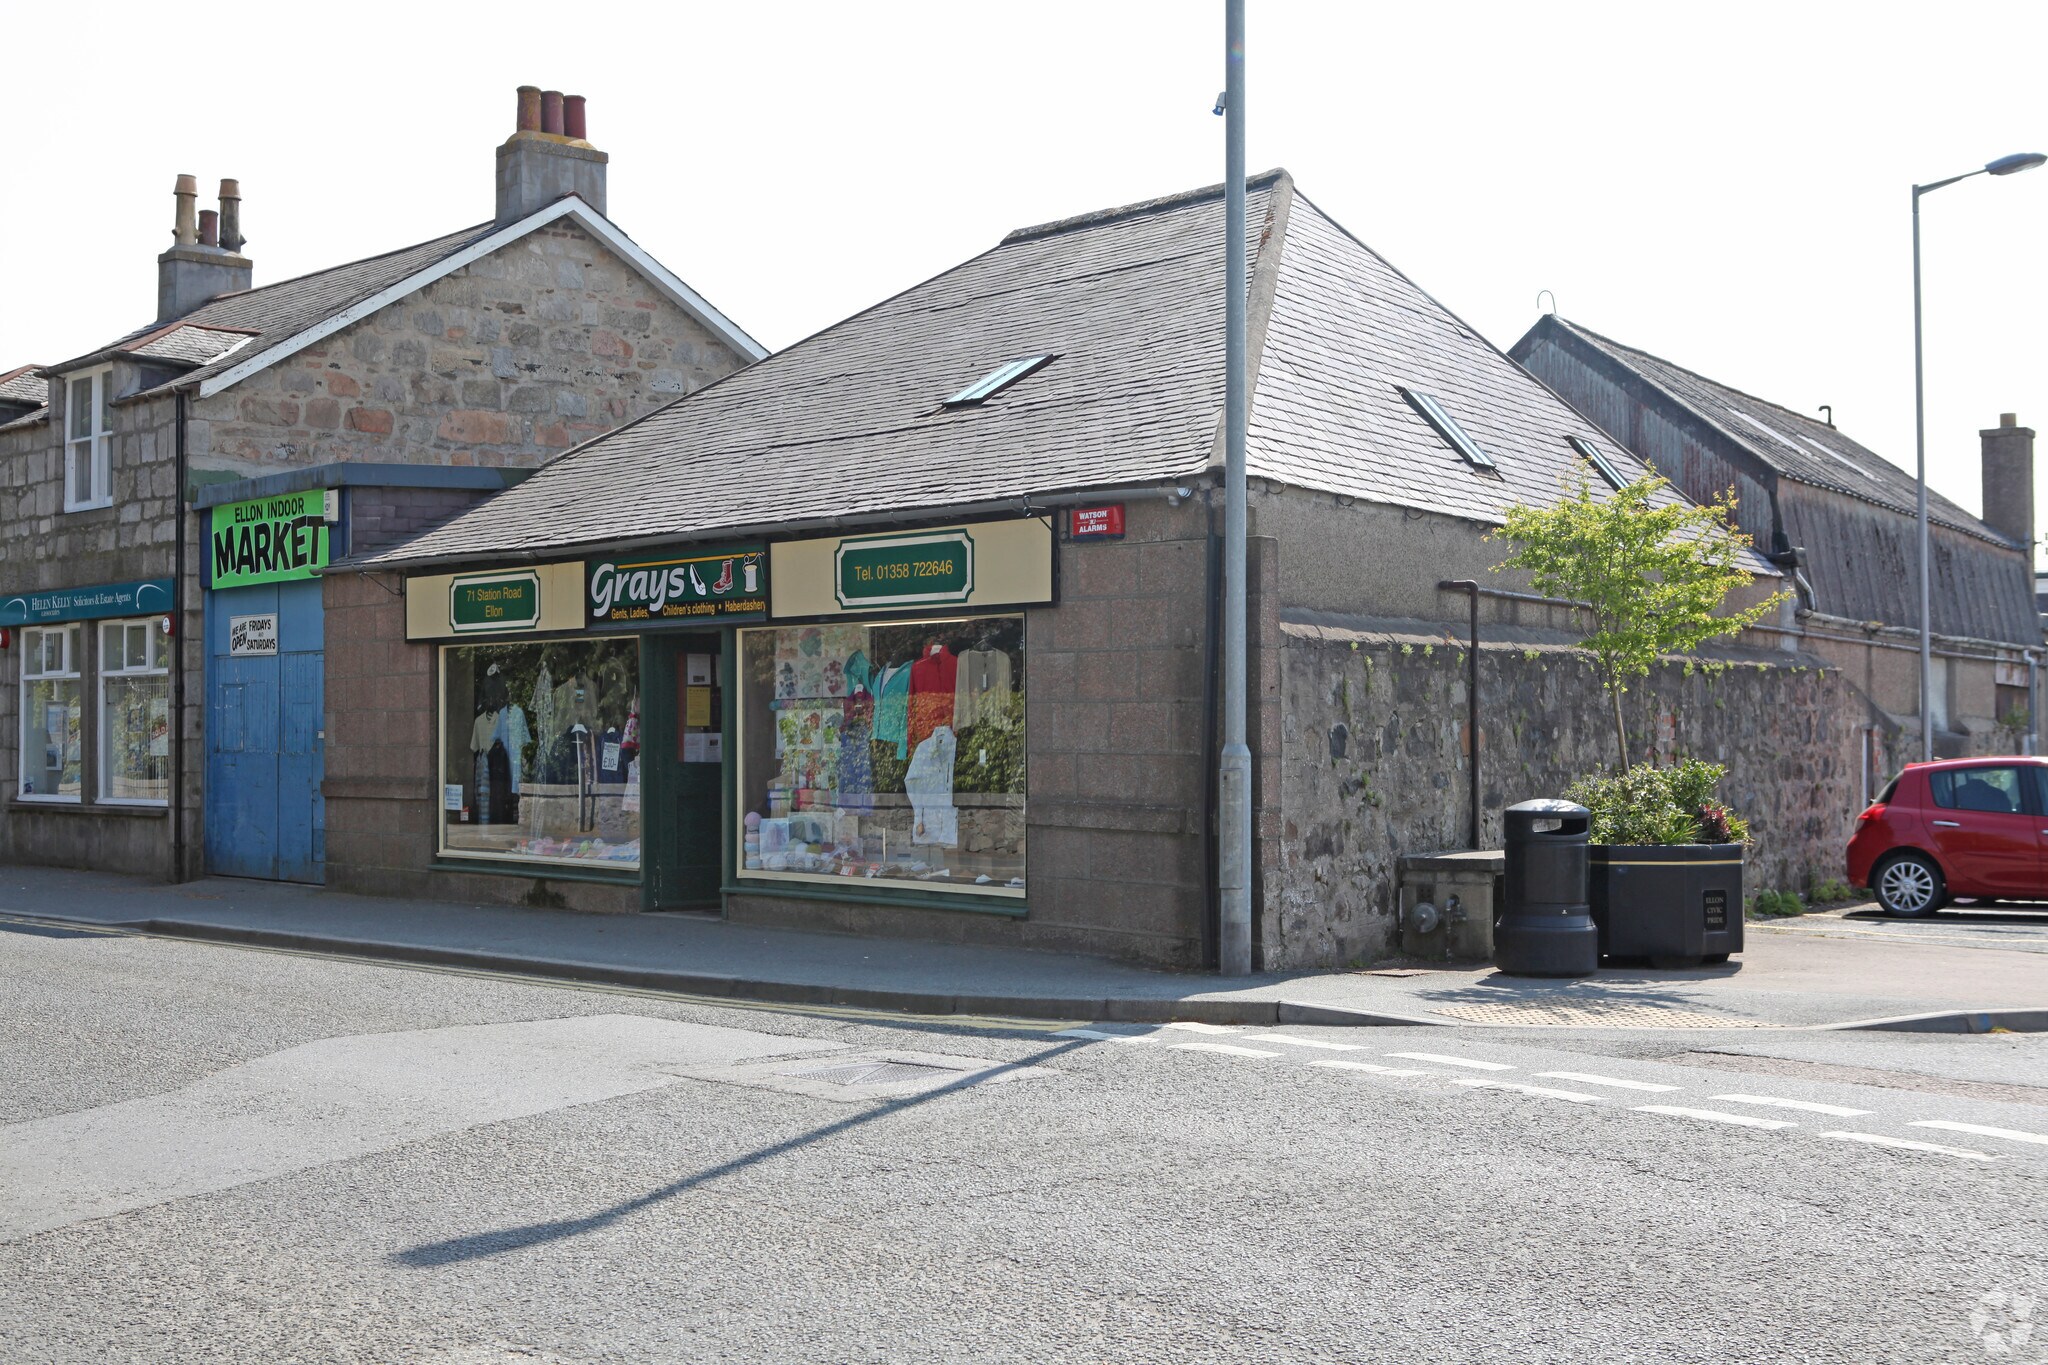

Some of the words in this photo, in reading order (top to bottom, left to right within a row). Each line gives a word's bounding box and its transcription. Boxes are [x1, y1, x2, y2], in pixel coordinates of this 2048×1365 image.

[235, 504, 263, 523] ELLON
[267, 497, 305, 520] INDOOR
[1079, 510, 1107, 520] WATSON
[1079, 524, 1107, 533] ALARMS
[214, 515, 327, 580] MARKET
[855, 565, 873, 581] Tel.
[877, 563, 909, 579] 01358
[913, 559, 953, 577] 722646
[466, 590, 476, 602] 71
[477, 588, 501, 602] Station
[503, 585, 522, 599] Road
[591, 563, 685, 617] Grays
[32, 598, 51, 610] HELEN
[52, 596, 71, 608] KELLY
[74, 595, 95, 606] Solicitors
[95, 594, 100, 605] &
[100, 593, 114, 604] Estate
[115, 592, 131, 605] Agents
[485, 605, 503, 618] Ellon
[611, 608, 629, 620] Gents,
[630, 606, 650, 619] Ladies,
[662, 603, 691, 616] Children's
[692, 602, 715, 615] clothing
[725, 599, 766, 612] Haberdashery
[248, 619, 271, 631] FRIDAYS
[232, 631, 248, 651] OPEN
[247, 638, 276, 650] SATURDAYS
[1707, 906, 1723, 914] CIVIC
